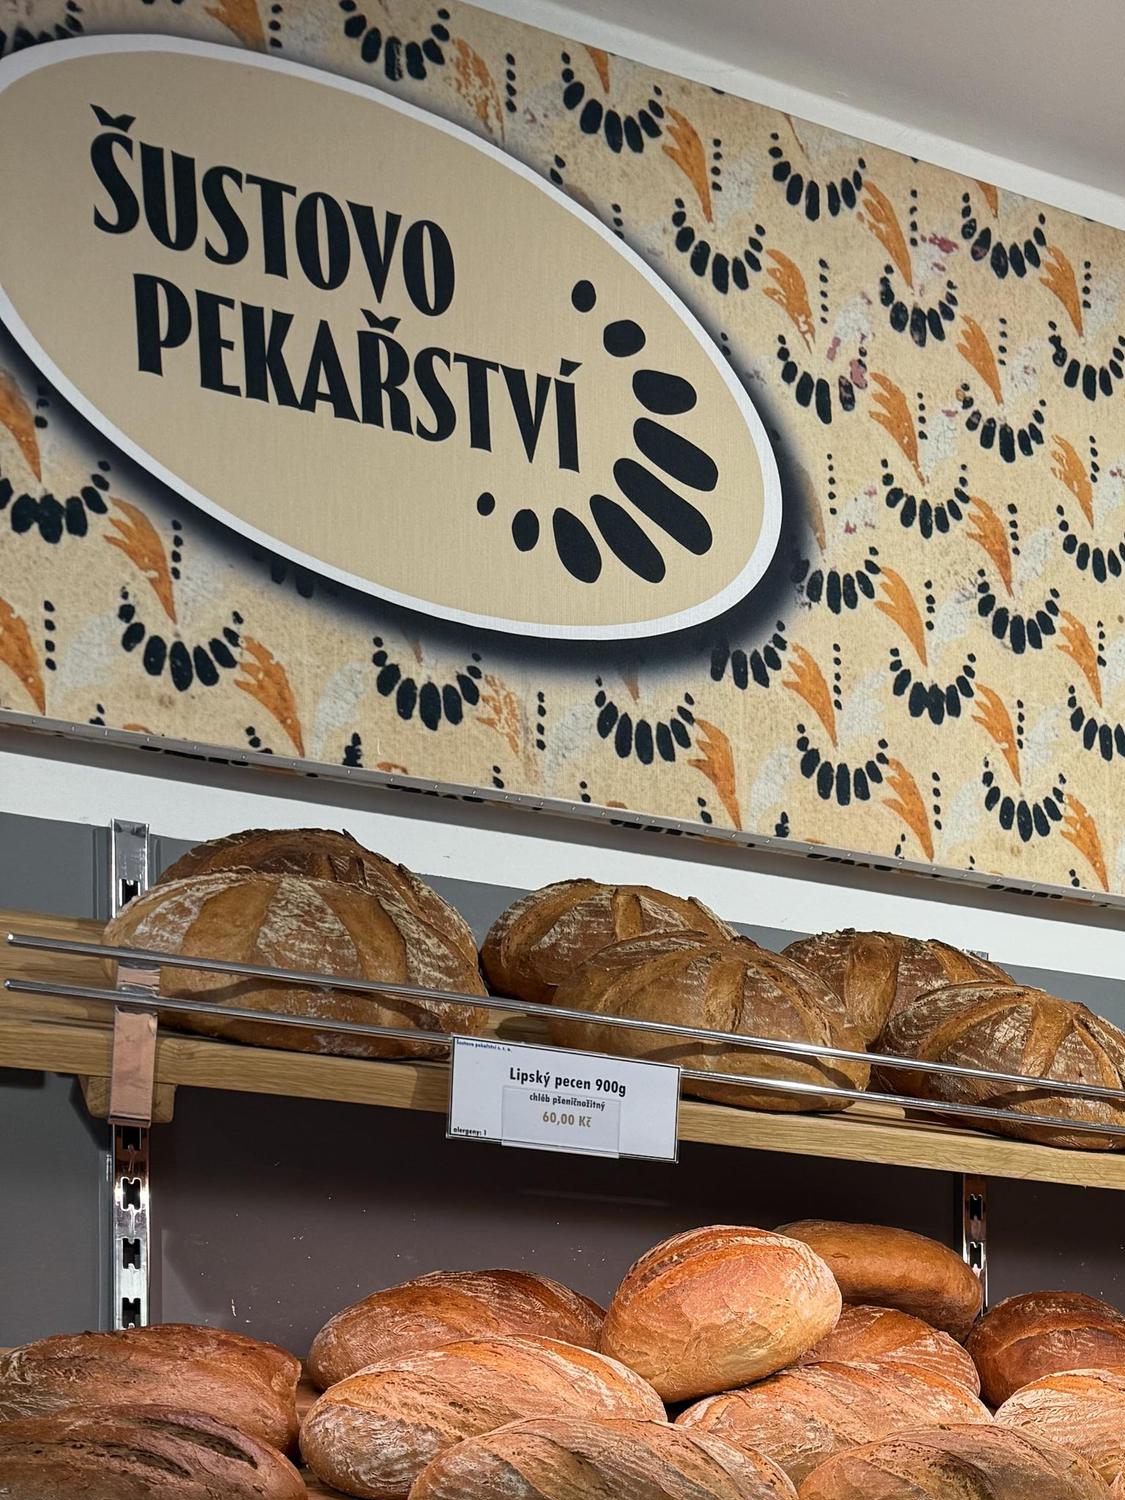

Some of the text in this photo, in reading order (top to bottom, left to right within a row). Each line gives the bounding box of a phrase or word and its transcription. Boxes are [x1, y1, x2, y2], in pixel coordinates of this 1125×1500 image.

[91, 104, 455, 317] ŠUSTOVO
[132, 273, 582, 474] PEKAŘSTVÍ
[510, 1067, 626, 1097] Lipský pecen 900g
[529, 1093, 605, 1112] chléb pšeničnožitný
[542, 1111, 592, 1128] 60,00 Kč
